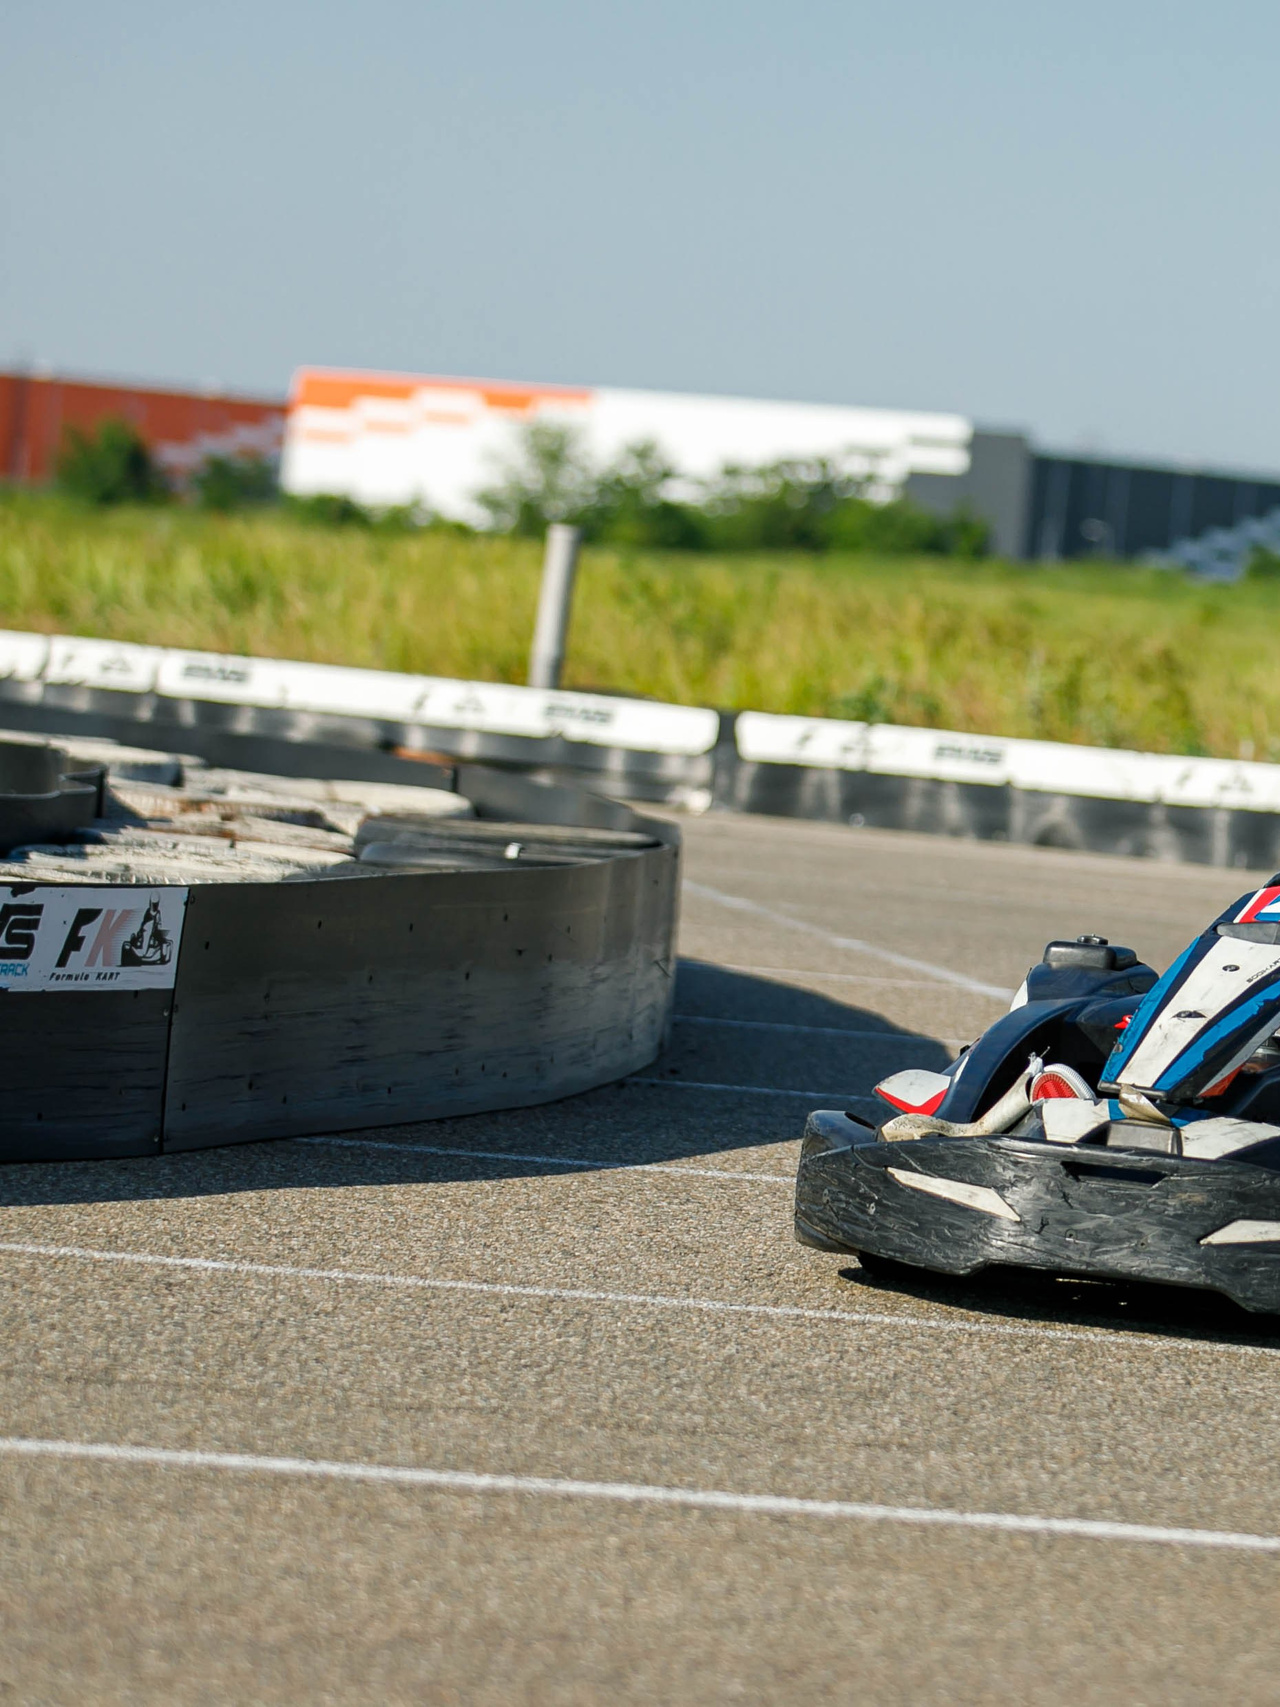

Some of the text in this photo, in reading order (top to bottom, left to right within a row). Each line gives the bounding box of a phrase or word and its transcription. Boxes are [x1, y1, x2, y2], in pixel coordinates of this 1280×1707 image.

[55, 908, 134, 968] FK
[0, 963, 30, 977] RACK
[95, 972, 120, 981] KART
